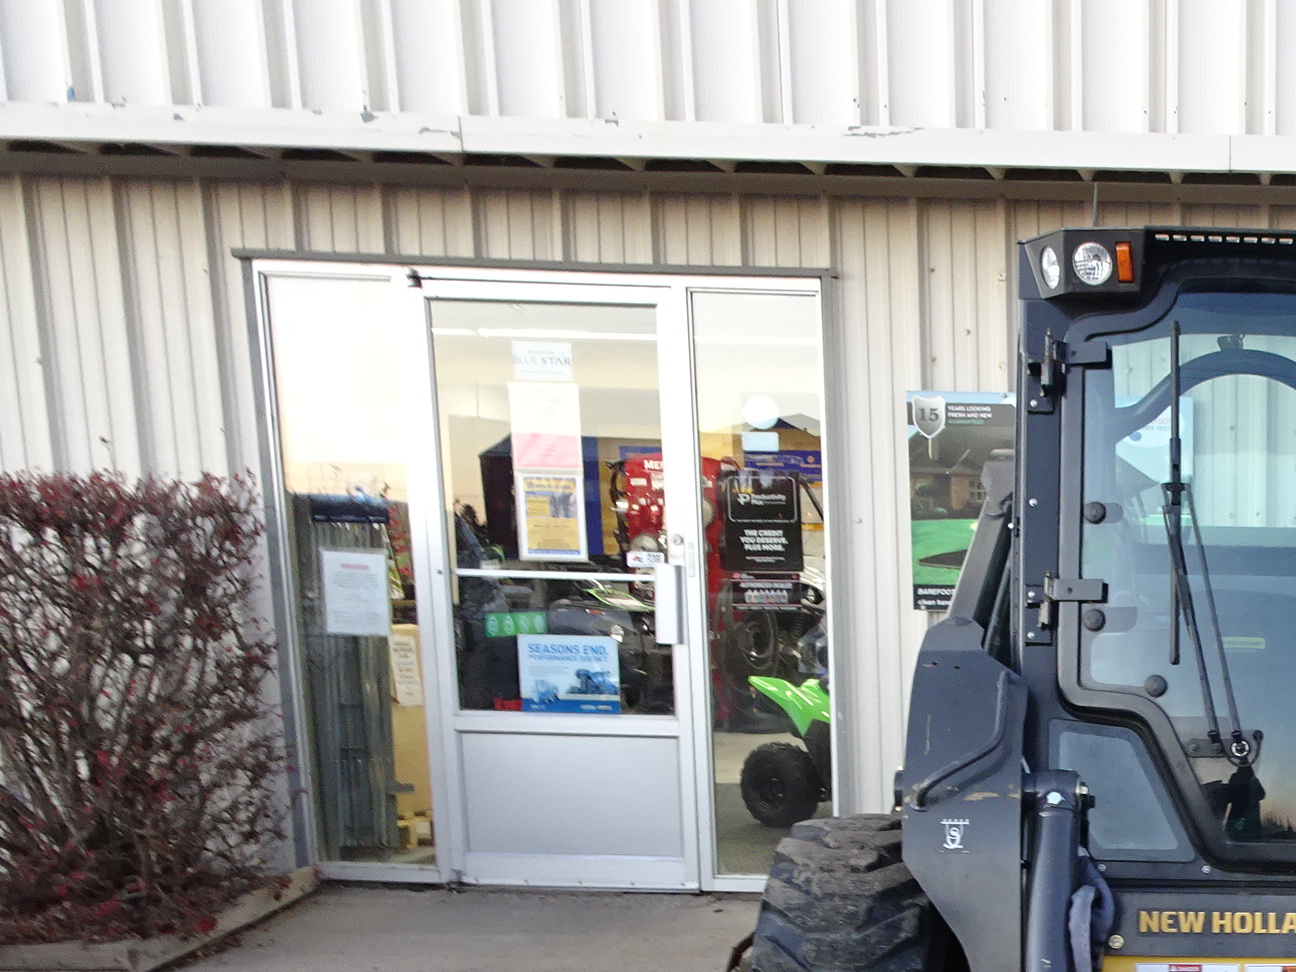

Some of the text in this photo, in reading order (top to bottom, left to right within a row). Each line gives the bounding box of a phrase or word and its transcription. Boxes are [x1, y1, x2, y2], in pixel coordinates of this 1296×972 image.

[540, 356, 571, 367] STAR
[919, 407, 940, 422] 15
[744, 529, 784, 537] THE CREDIT
[740, 536, 756, 544] YOU
[528, 643, 581, 655] SEASONS
[1138, 911, 1206, 933] NEW
